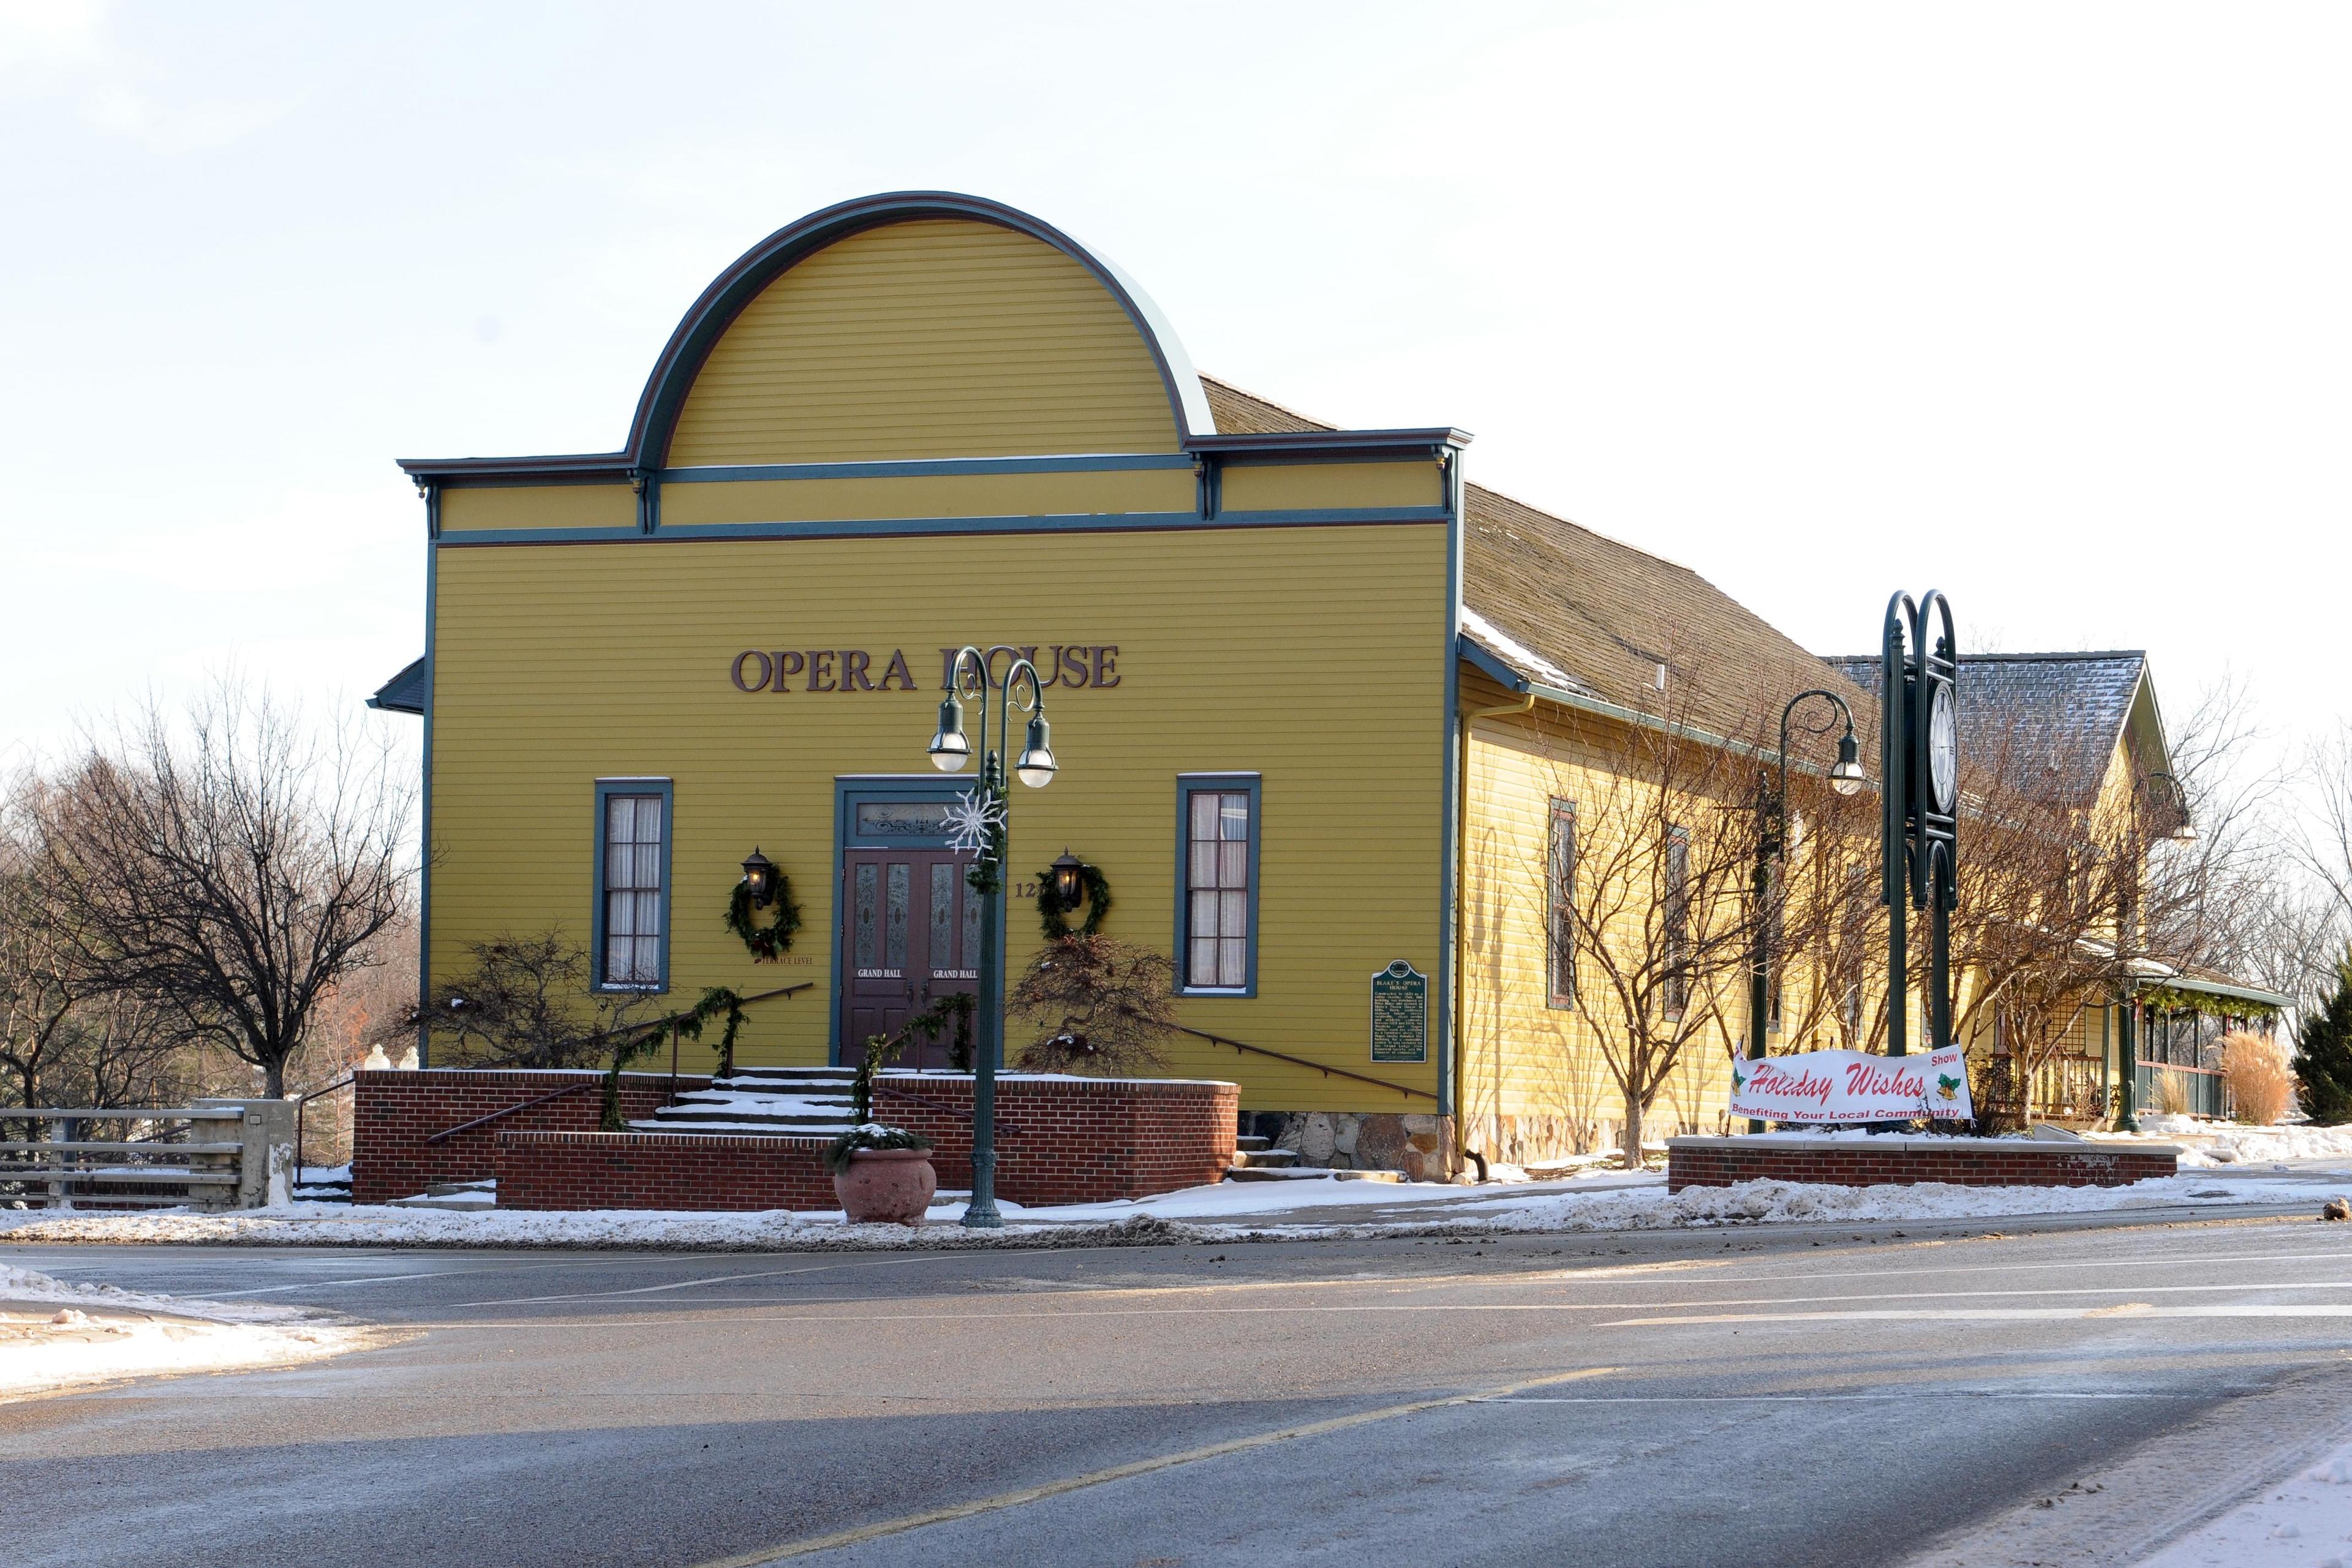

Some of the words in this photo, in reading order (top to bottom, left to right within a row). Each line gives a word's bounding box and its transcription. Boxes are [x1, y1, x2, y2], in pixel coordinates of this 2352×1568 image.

[730, 648, 918, 693] OPERA
[939, 645, 1121, 690] HOUSE
[858, 969, 882, 978] GRAND
[884, 969, 902, 978] HALL
[933, 970, 958, 979] GRAND
[960, 970, 978, 979] HALL
[1931, 1054, 1958, 1066] Show
[1749, 1064, 1833, 1106] Holiday
[1846, 1063, 1924, 1098] Wishes
[1732, 1103, 1789, 1120] Benefiting
[1793, 1110, 1825, 1120] Your
[1830, 1110, 1869, 1119] Local
[1875, 1109, 1960, 1119] Community
